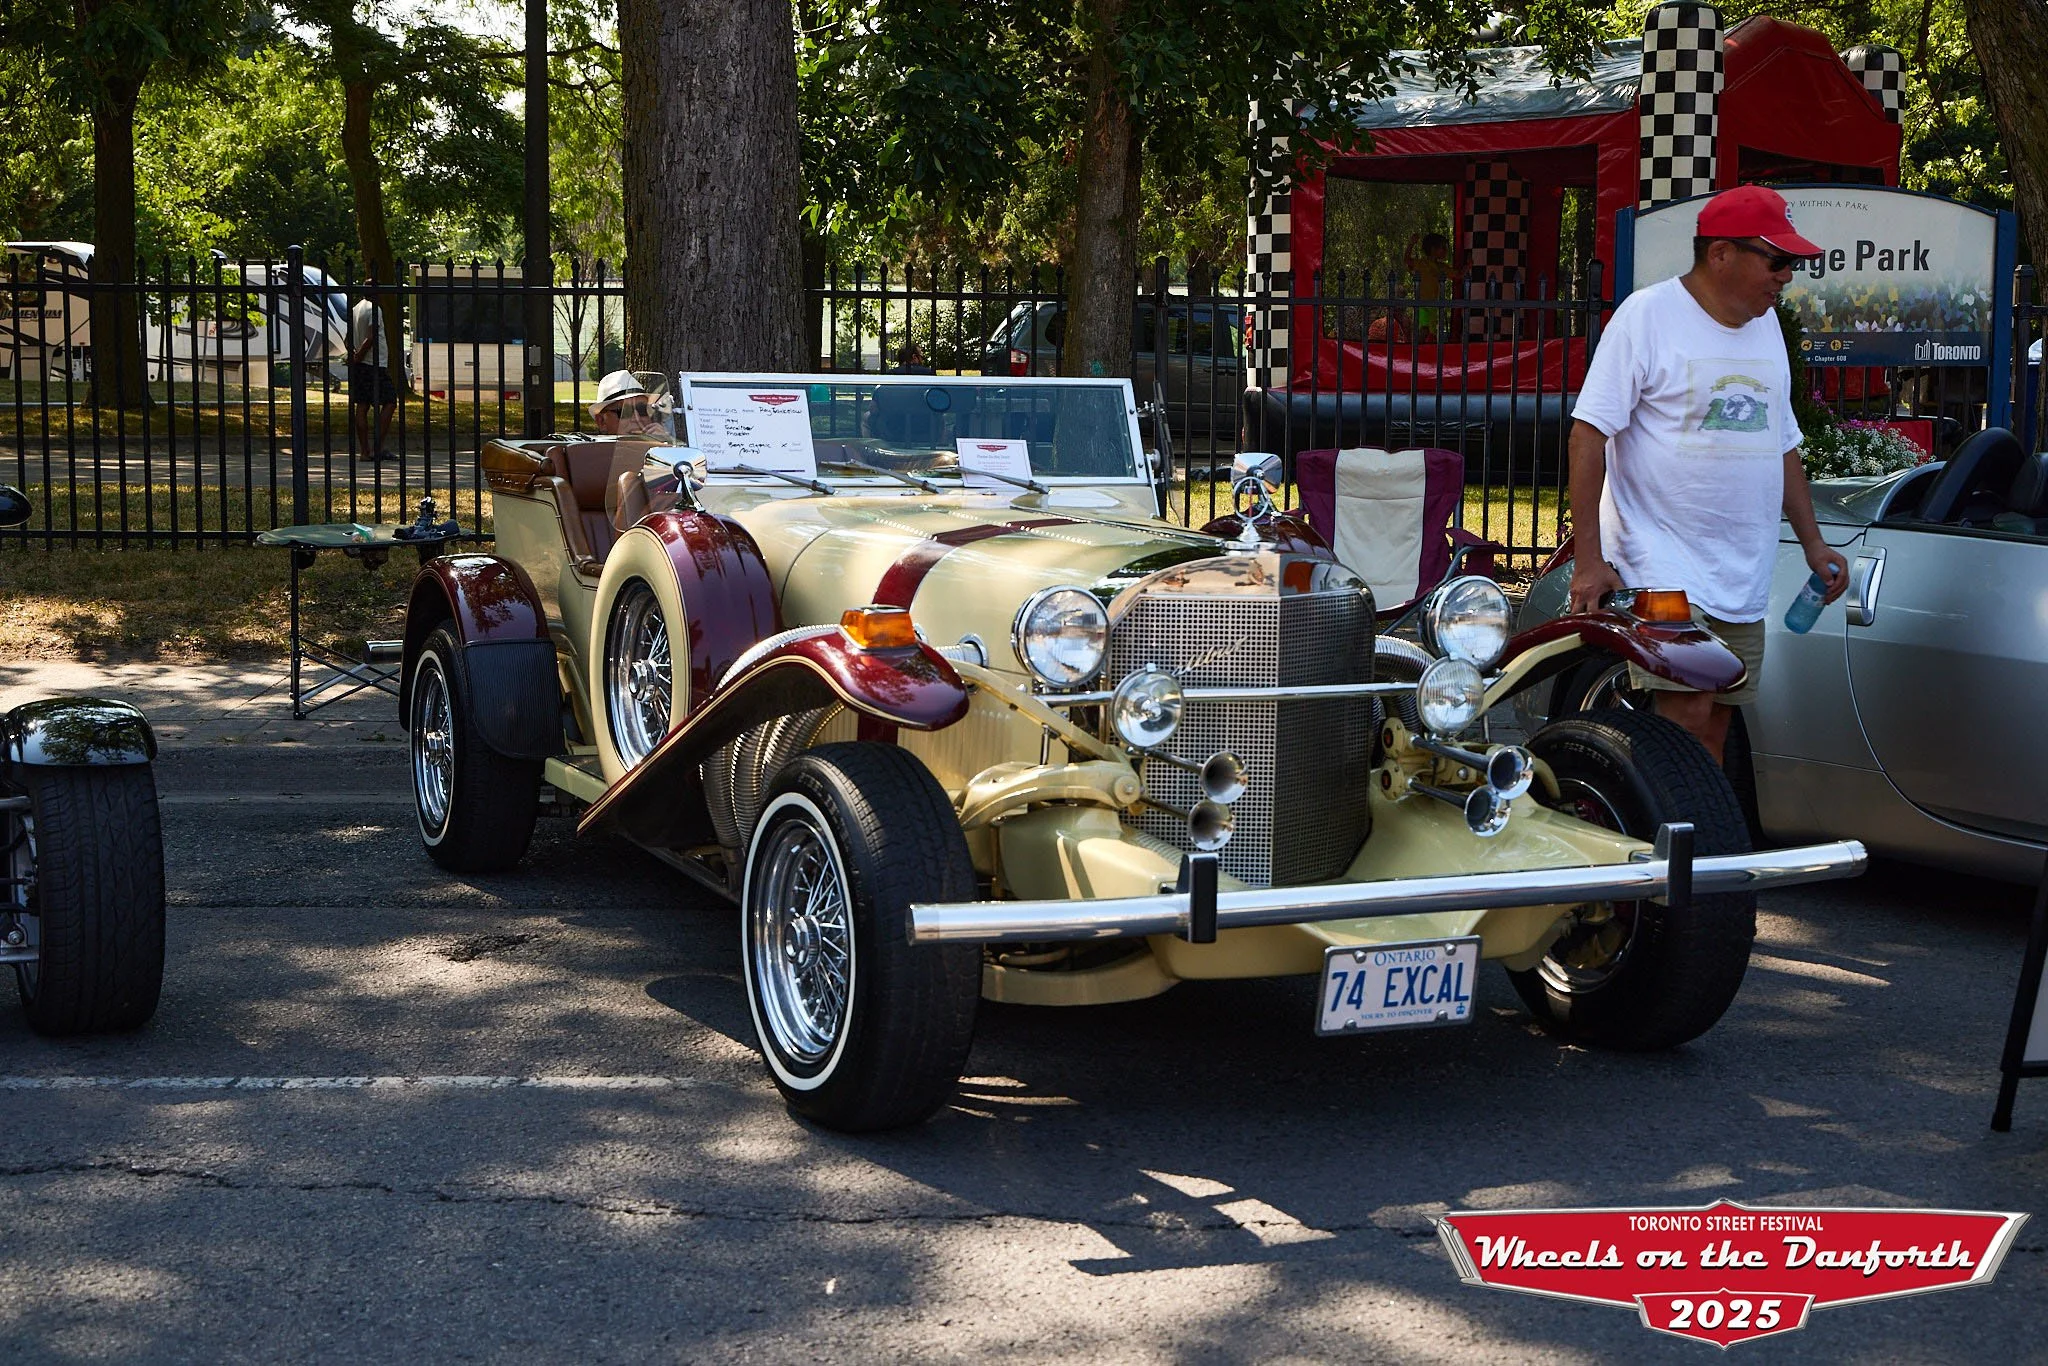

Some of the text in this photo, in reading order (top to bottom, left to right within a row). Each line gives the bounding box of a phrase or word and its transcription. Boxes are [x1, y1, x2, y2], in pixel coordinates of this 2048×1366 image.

[1799, 200, 1832, 208] WITHIN
[1845, 201, 1868, 211] PARK
[1855, 239, 1930, 271] Park
[1814, 355, 1835, 363] Chapter
[1931, 342, 1981, 361] TORONTO
[1374, 950, 1436, 967] ONTARIO
[1330, 962, 1470, 1012] 74 EXCAL
[1398, 1008, 1433, 1017] DISCOVER
